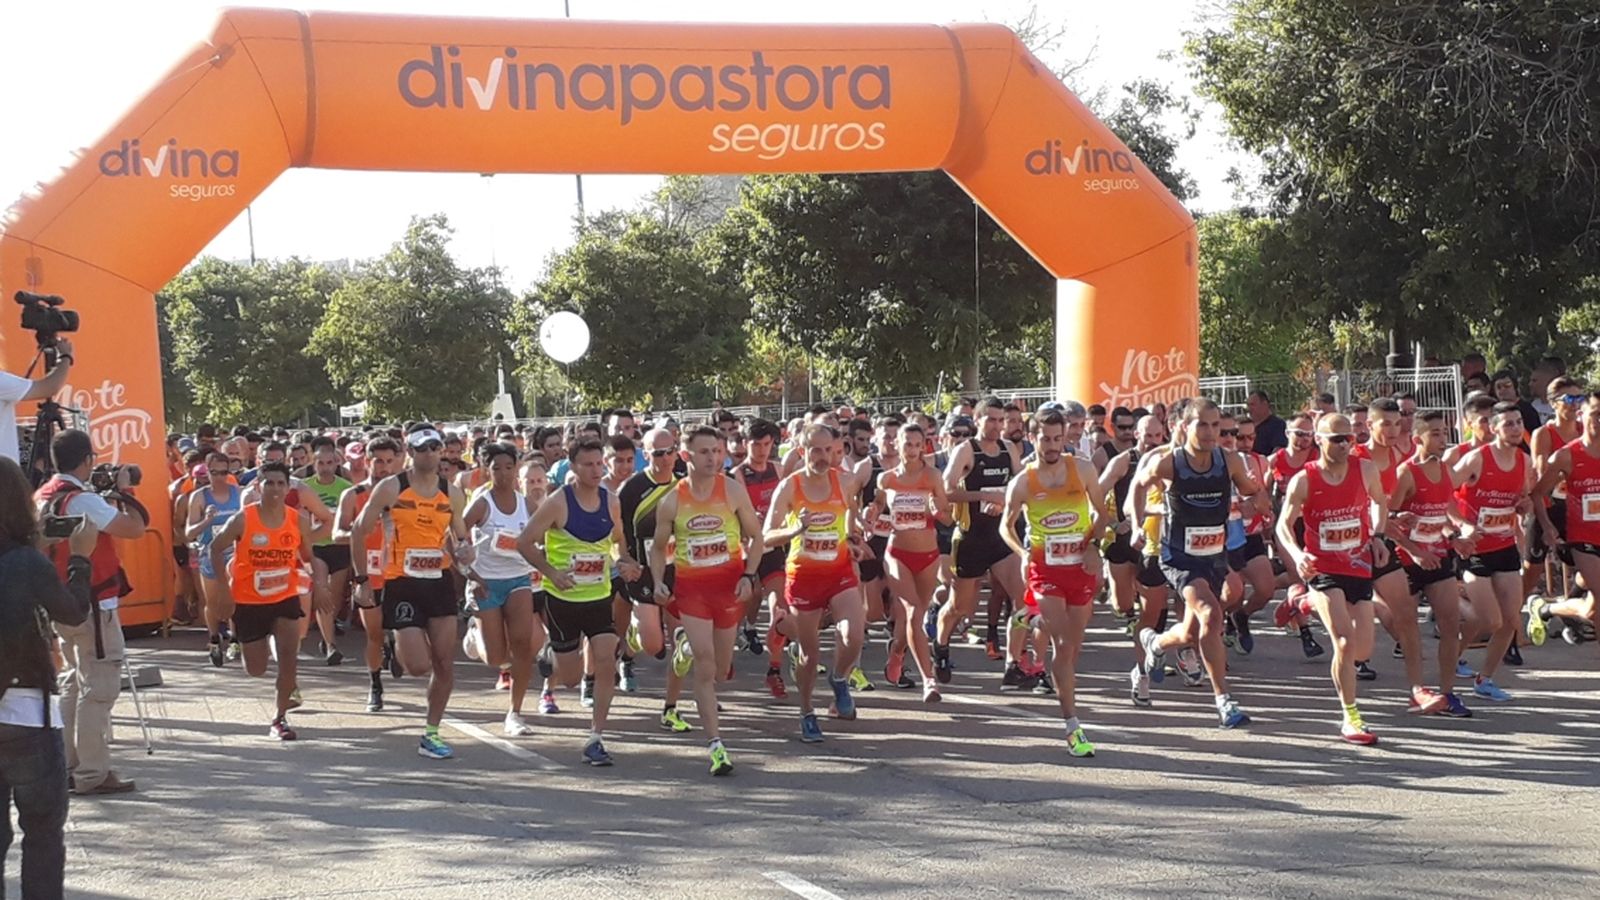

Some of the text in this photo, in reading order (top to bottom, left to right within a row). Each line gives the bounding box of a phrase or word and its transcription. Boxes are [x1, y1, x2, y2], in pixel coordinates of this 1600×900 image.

[397, 44, 892, 126] divinapastora
[708, 121, 886, 160] seguros
[99, 138, 240, 178] divina
[1025, 138, 1136, 175] divina
[169, 183, 236, 201] seguros
[1083, 178, 1139, 194] seguros
[1121, 346, 1185, 389] No te
[94, 379, 128, 410] te
[805, 540, 838, 551] 2185
[1192, 532, 1224, 547] 2037
[1327, 527, 1360, 541] 2109
[692, 541, 728, 557] 2196
